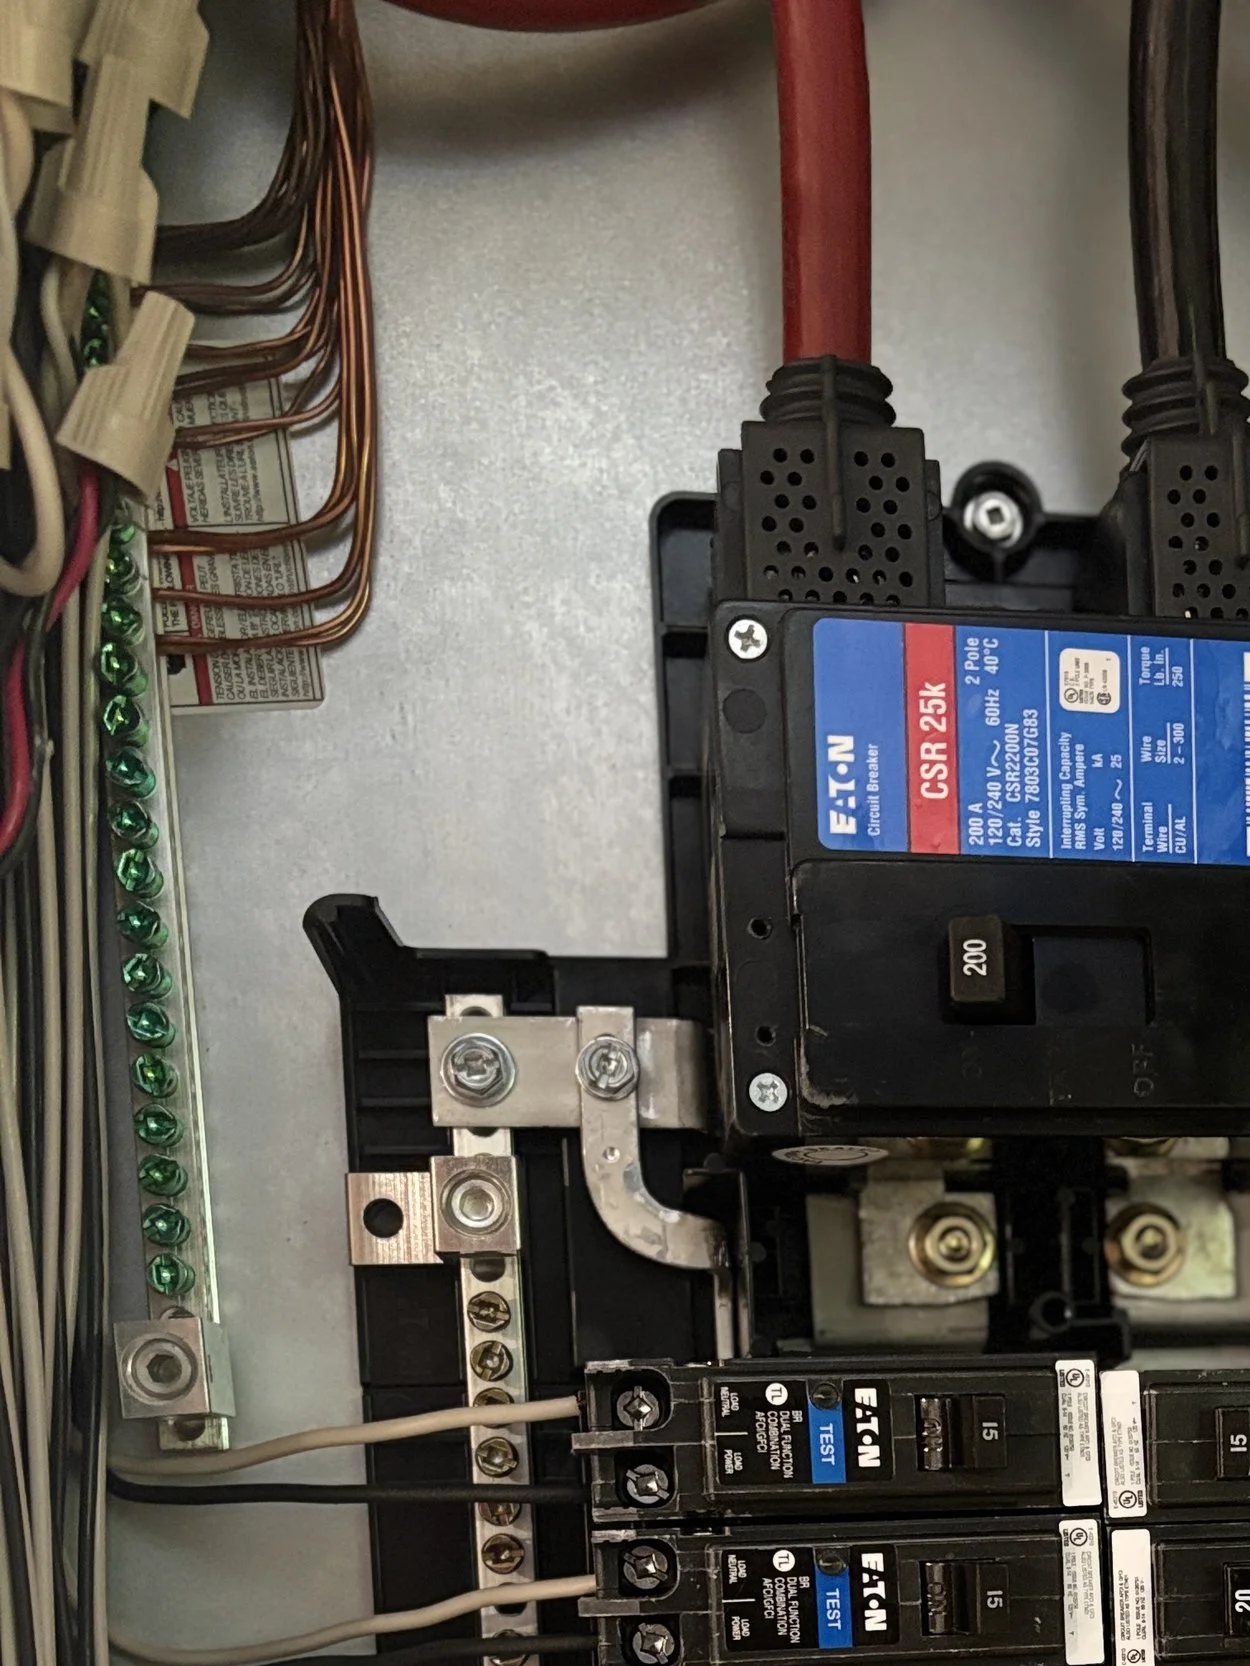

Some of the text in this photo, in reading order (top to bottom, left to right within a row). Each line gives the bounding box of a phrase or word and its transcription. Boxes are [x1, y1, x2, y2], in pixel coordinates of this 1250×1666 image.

[198, 565, 209, 590] PEUT
[213, 659, 224, 700] TENSION
[223, 662, 235, 700] CAUSER
[966, 637, 980, 684] 2 Pole
[983, 637, 1001, 726] 60Hz 40°C
[1138, 646, 1153, 685] Torque
[1152, 650, 1166, 686] Lb. In.
[1170, 666, 1183, 687] 250
[918, 682, 948, 799] CSR 25k
[1140, 736, 1153, 762] Wire
[1154, 739, 1167, 763] Size
[1172, 723, 1185, 744] 300
[827, 735, 856, 835] EATON
[865, 744, 880, 836] Circuit Breaker
[1004, 723, 1021, 846] Cat. CSR2200N
[1023, 709, 1042, 848] Style 7803C07G83
[1058, 732, 1074, 849] Interrupting Capacity
[1073, 744, 1088, 849] RMS Sym. Ampere
[988, 781, 1004, 846] 120/240
[1092, 753, 1105, 850] Volt kA
[1110, 754, 1124, 851] 120/240 25
[968, 803, 984, 845] 200 A
[1142, 802, 1154, 852] Terminal
[1156, 826, 1168, 853] Wire
[1173, 816, 1187, 854] CU/AL
[963, 938, 987, 976] 200
[819, 1423, 836, 1466] TEST
[854, 1388, 881, 1468] EATON
[981, 1421, 998, 1440] 15
[1230, 1434, 1246, 1453] 15
[774, 1577, 788, 1636] COMBINATION
[787, 1577, 800, 1644] DUAL FUNCTION
[825, 1588, 842, 1631] TEST
[861, 1552, 887, 1632] EATON
[987, 1590, 1003, 1608] 15
